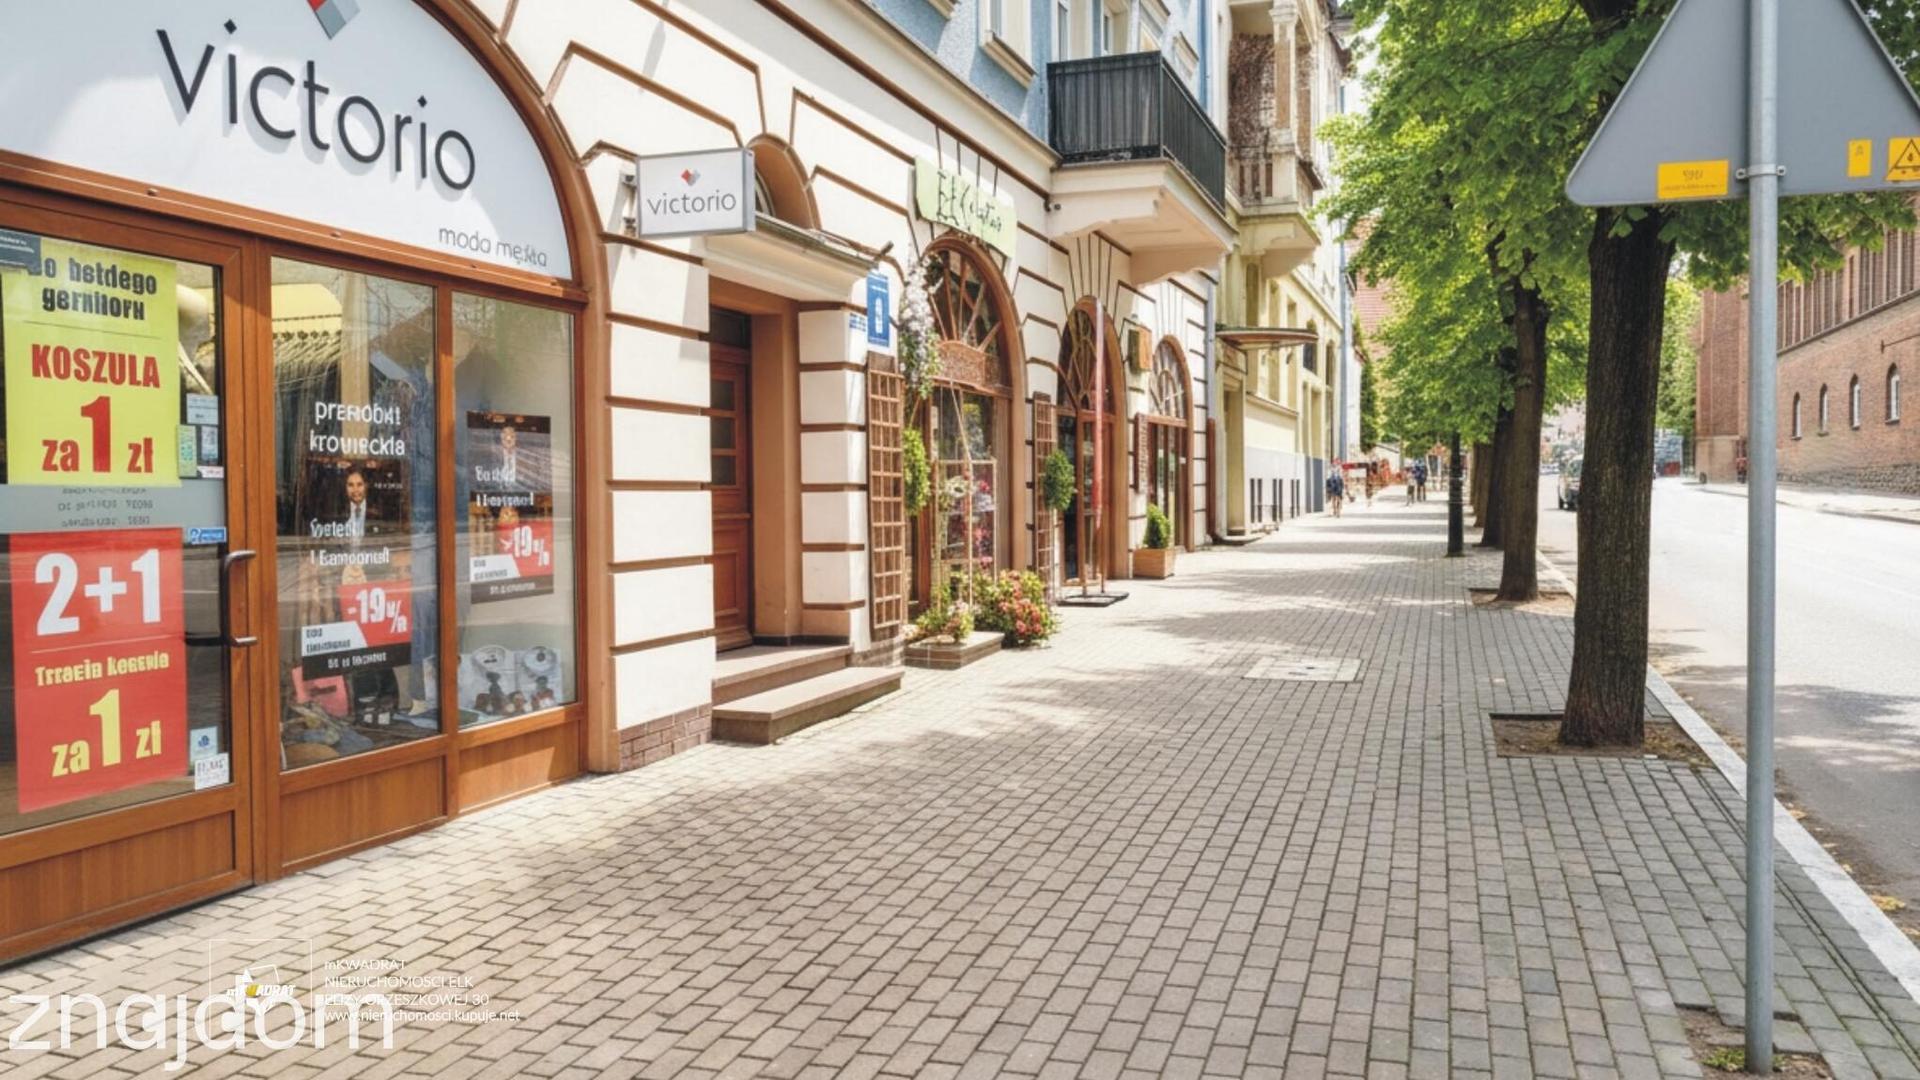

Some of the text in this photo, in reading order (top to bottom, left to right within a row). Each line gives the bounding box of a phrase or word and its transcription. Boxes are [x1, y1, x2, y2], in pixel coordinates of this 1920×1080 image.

[156, 19, 476, 190] victorio
[647, 190, 737, 216] victorio
[32, 343, 161, 388] KOSZULA
[42, 439, 80, 472] za
[80, 396, 111, 473] 1
[127, 437, 154, 473] zł
[35, 548, 161, 636] 2+1
[51, 688, 162, 778] za 1 zł
